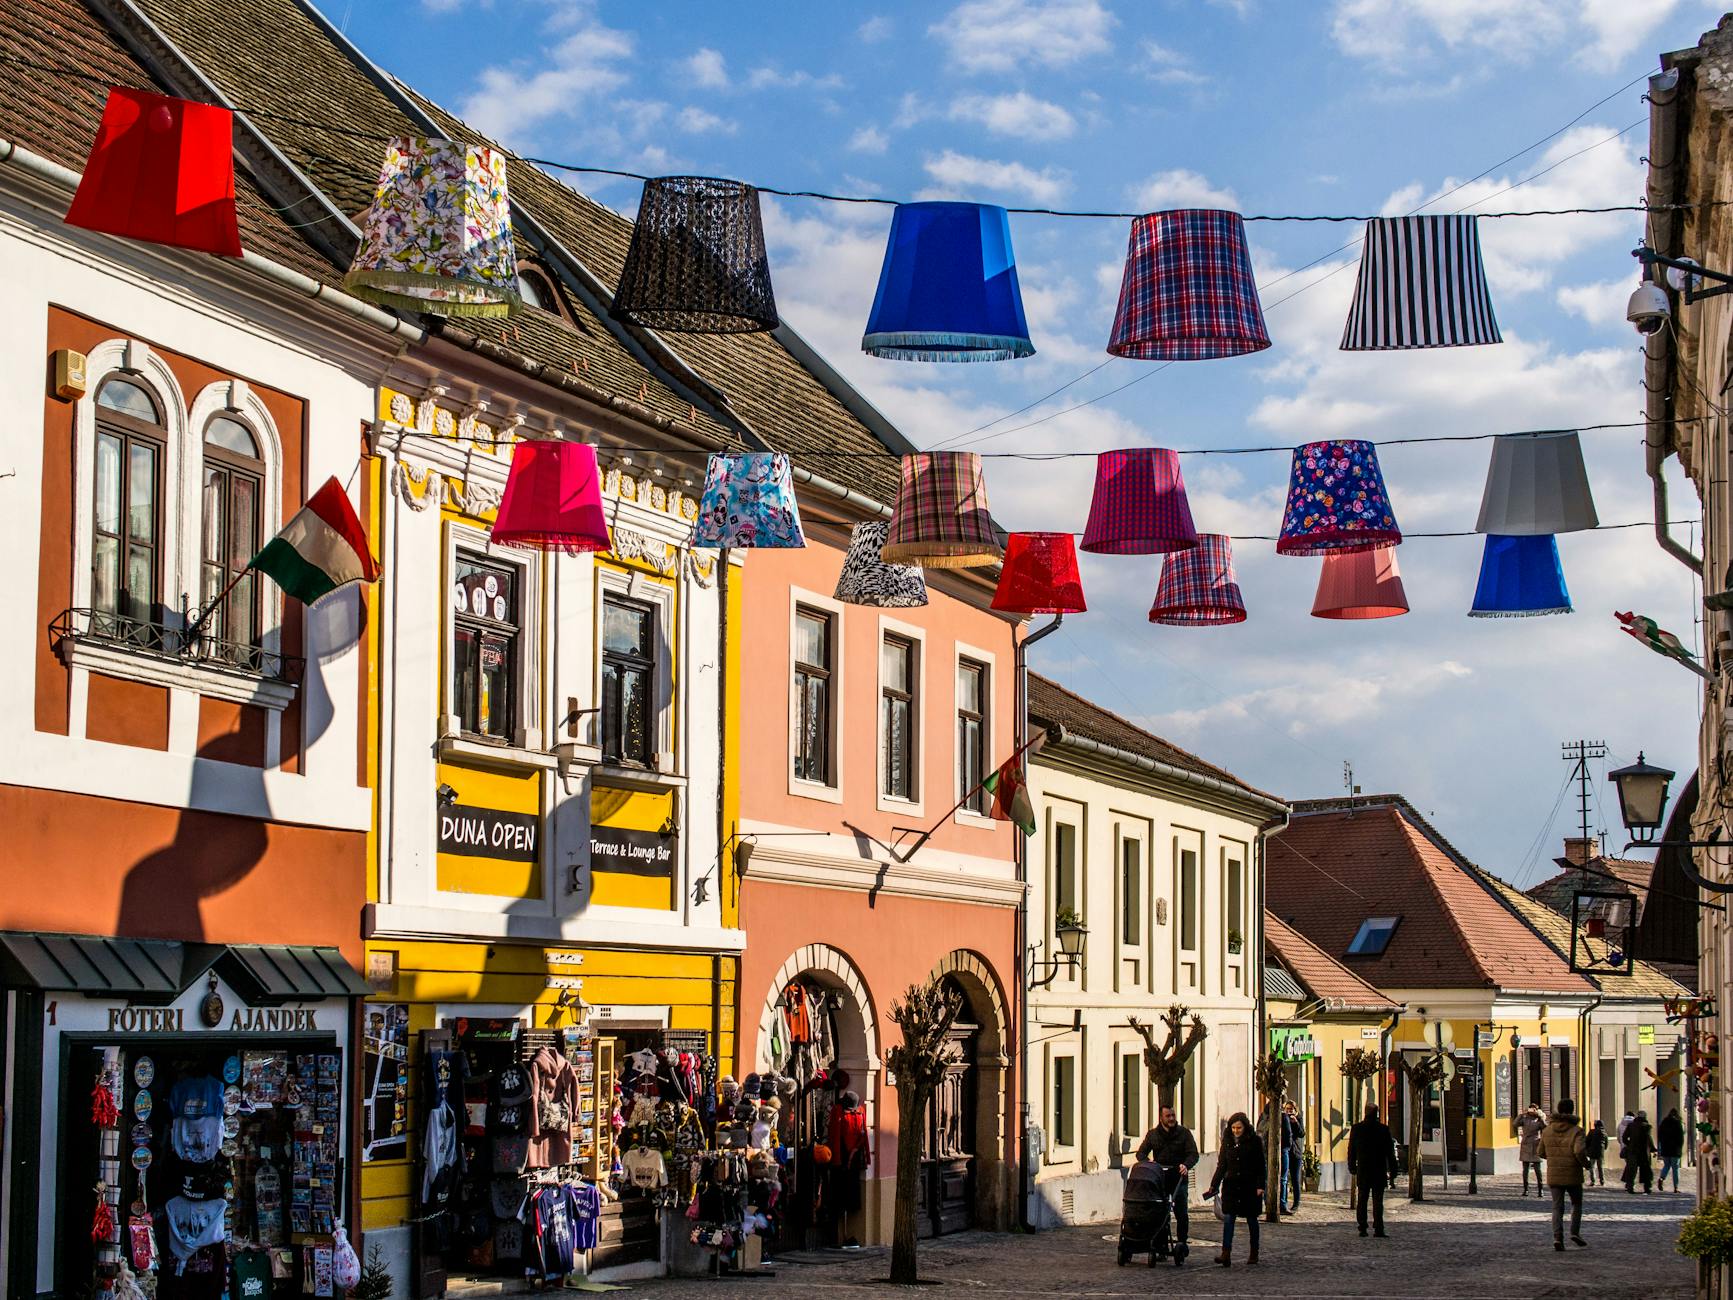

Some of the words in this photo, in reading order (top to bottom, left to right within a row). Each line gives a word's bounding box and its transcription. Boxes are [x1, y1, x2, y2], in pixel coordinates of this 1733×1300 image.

[441, 816, 487, 847] DUNA
[491, 821, 535, 851] OPEN
[590, 838, 619, 857] Terrace
[620, 845, 626, 857] &
[628, 842, 656, 863] Lounge
[657, 845, 671, 861] Bar
[46, 1001, 57, 1026] 1
